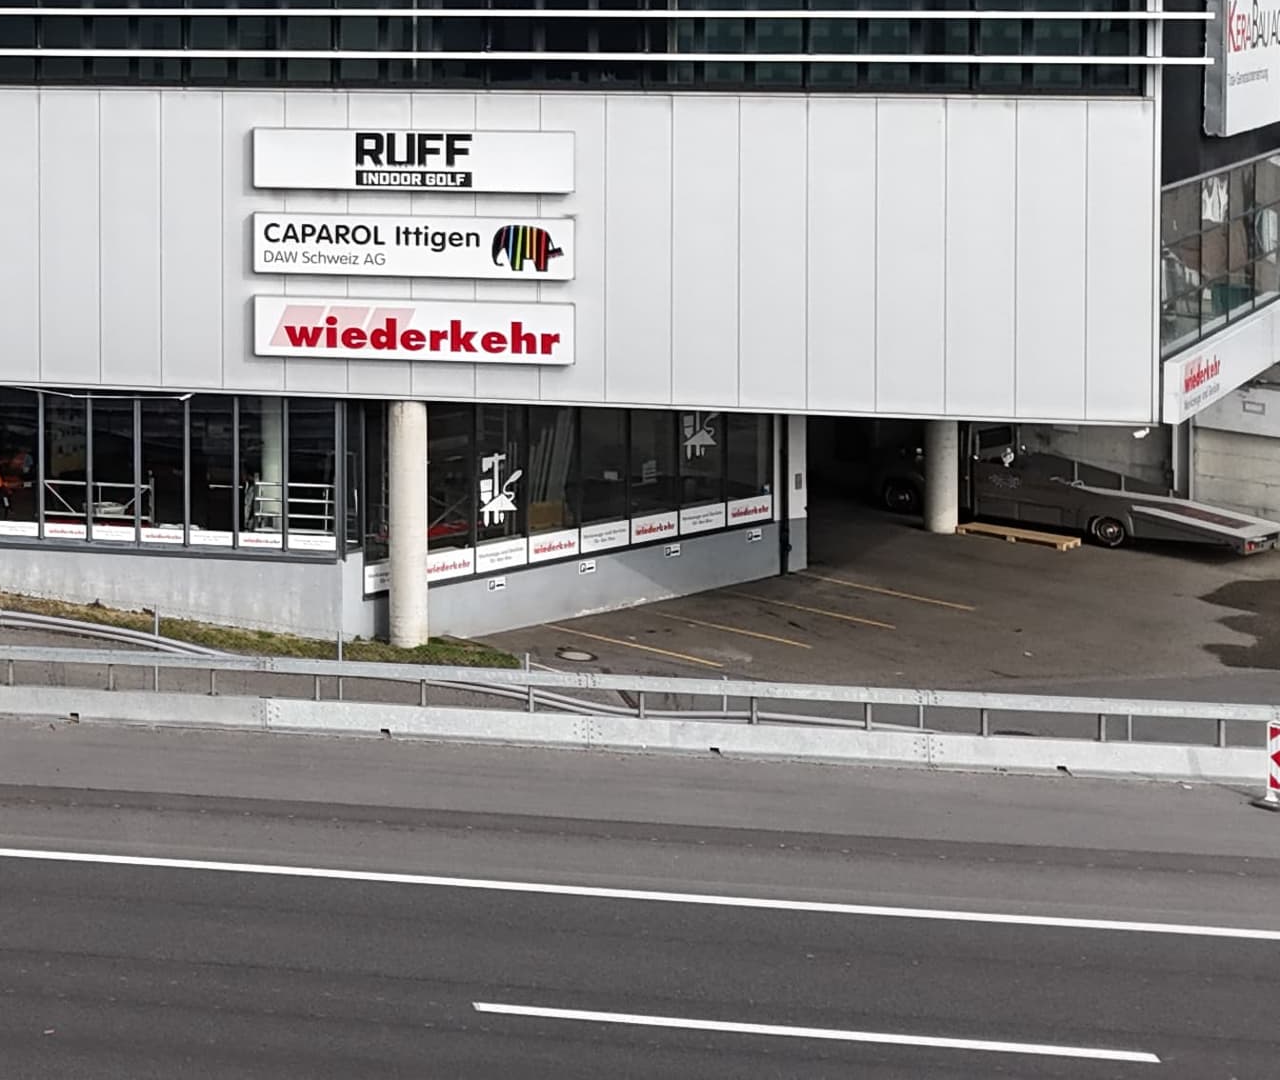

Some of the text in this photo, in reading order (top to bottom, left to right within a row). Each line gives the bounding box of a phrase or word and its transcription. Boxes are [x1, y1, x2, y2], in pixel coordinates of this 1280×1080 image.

[355, 132, 473, 167] RUFF
[362, 172, 466, 187] INDOOR GOLF
[264, 223, 480, 253] CAPAROL Ittigen
[263, 250, 386, 266] DAW Schweiz AG
[284, 316, 560, 355] wiederkehr
